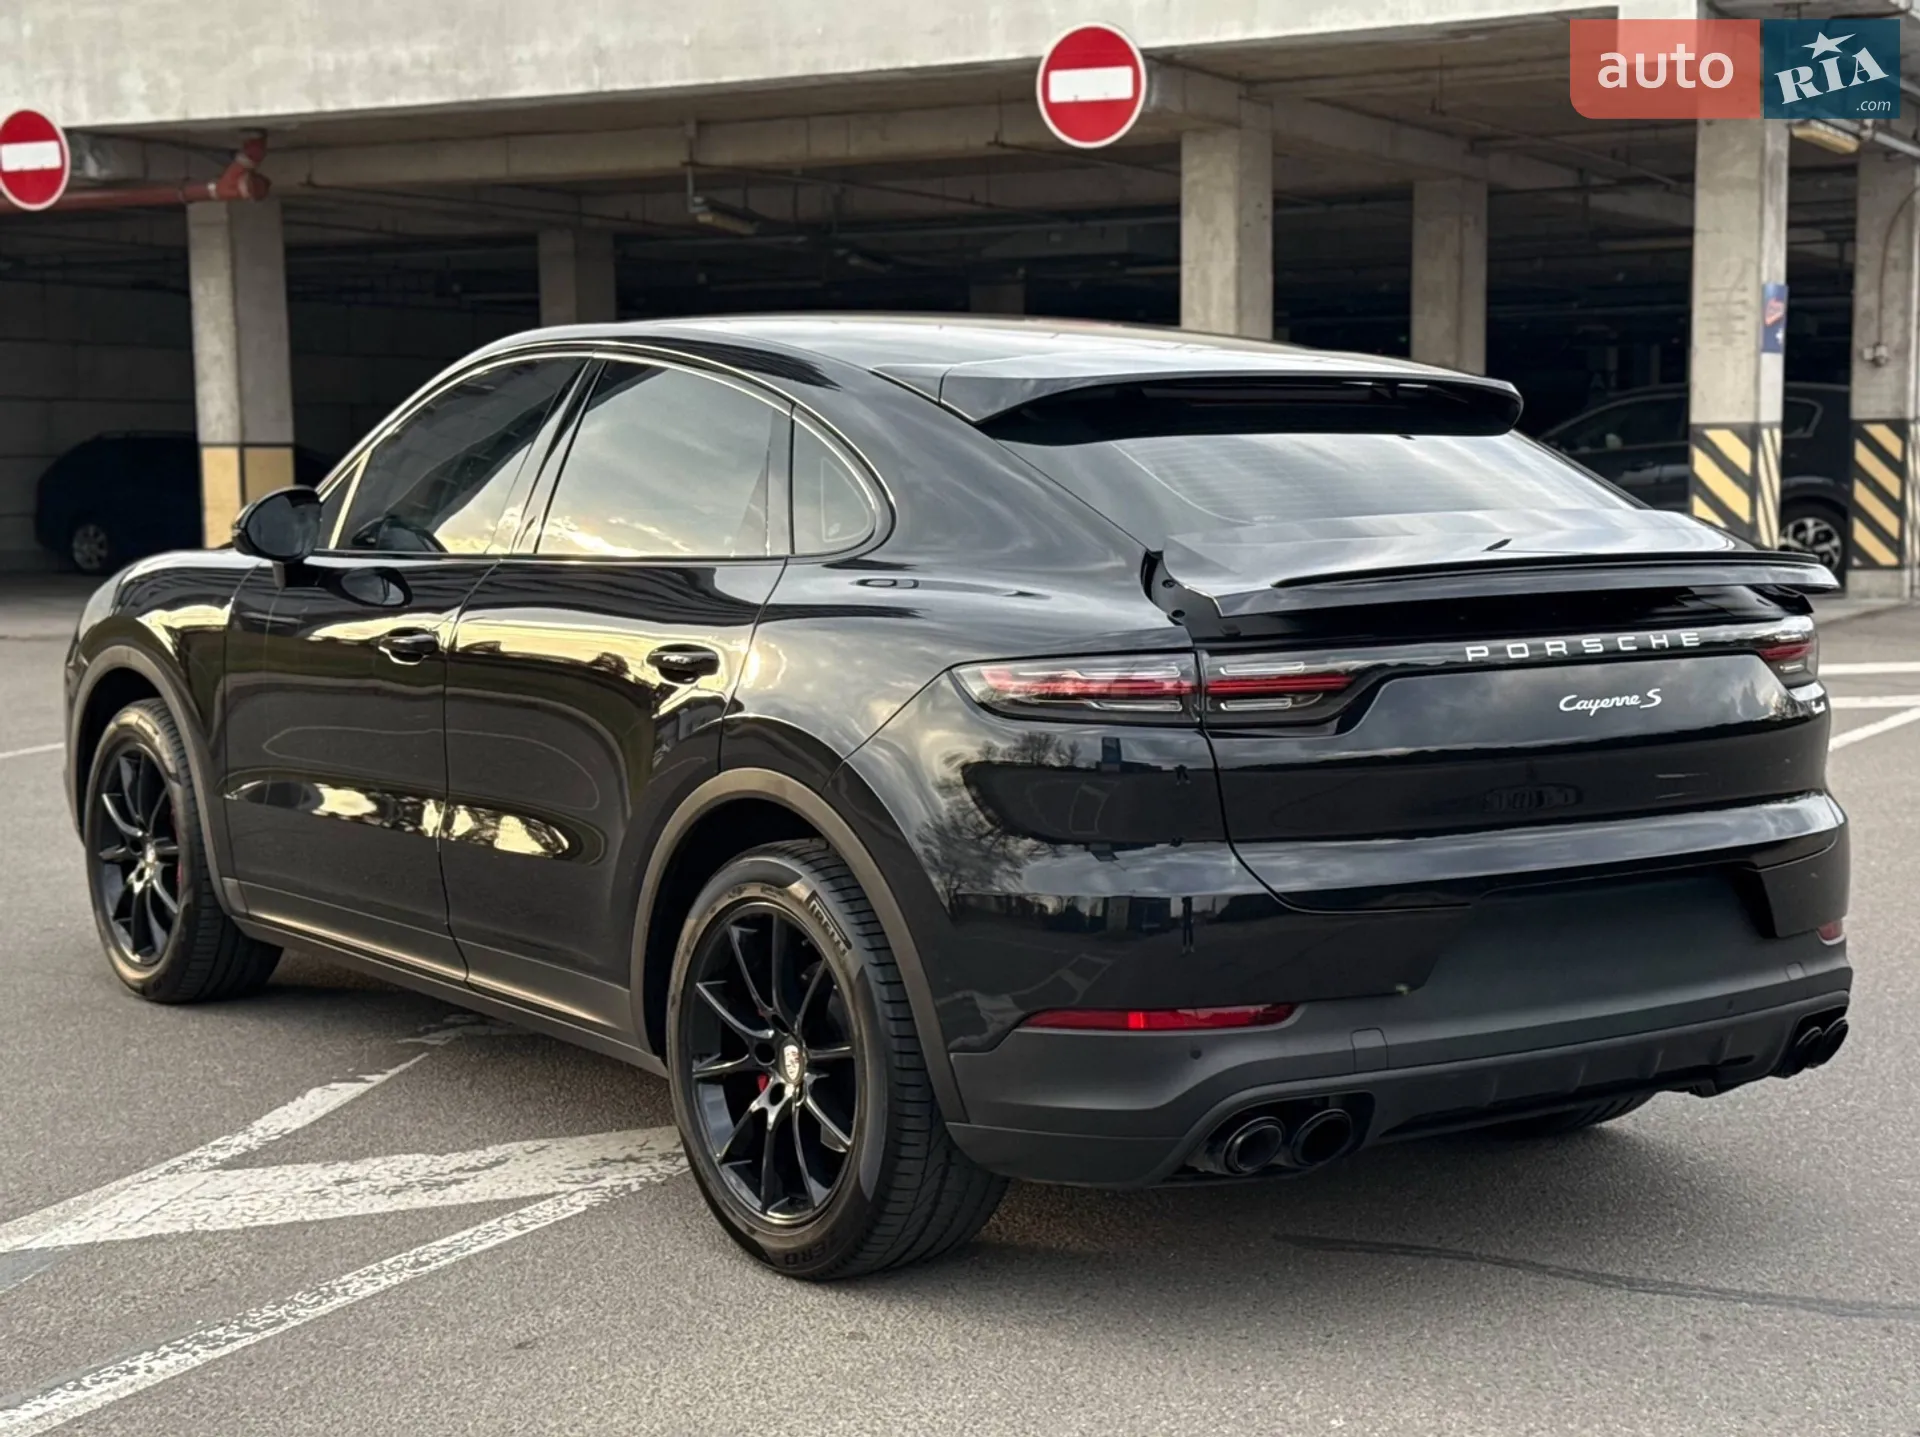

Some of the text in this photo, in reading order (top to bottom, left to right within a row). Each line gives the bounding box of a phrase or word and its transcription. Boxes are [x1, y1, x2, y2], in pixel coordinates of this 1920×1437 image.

[1464, 631, 1701, 661] PORSCHE
[1559, 688, 1662, 716] Cayenne S
